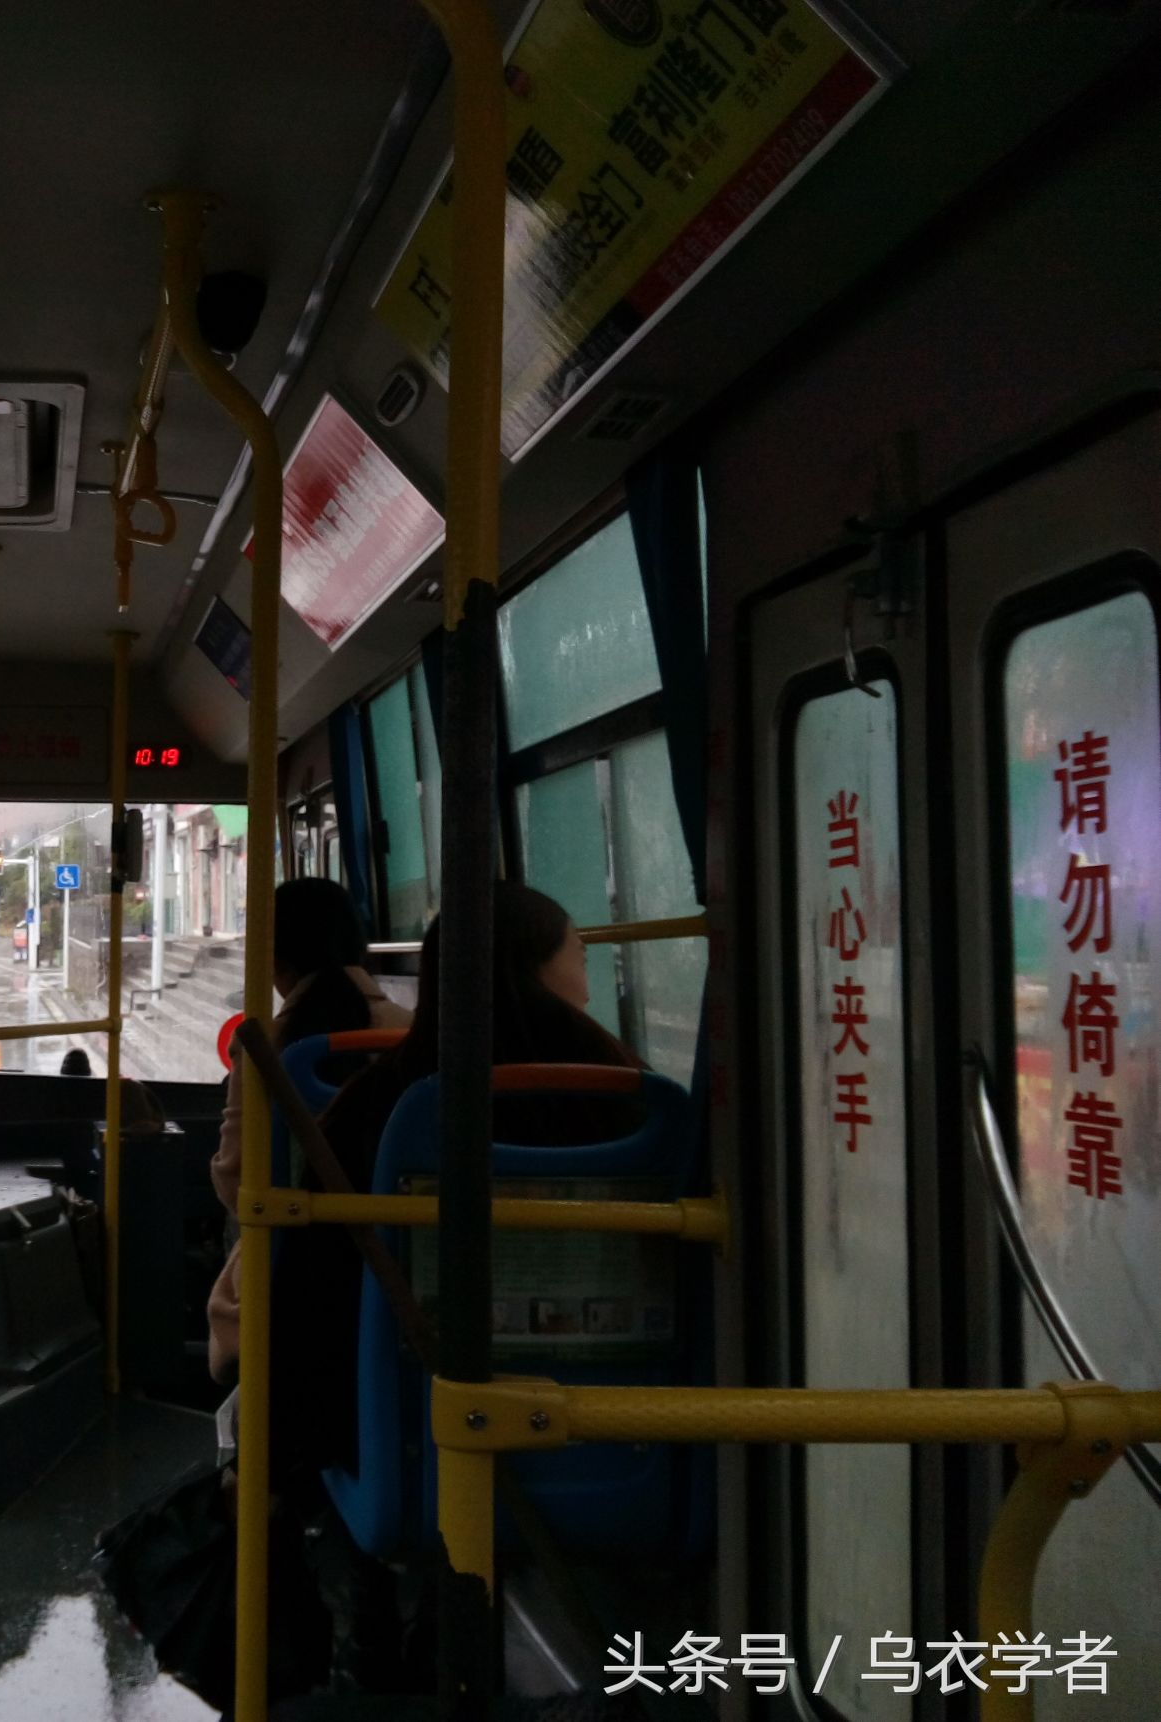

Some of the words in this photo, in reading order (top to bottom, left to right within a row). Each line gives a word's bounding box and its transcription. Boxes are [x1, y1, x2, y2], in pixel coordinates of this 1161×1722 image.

[827, 790, 871, 1153] 当心夹手
[1054, 731, 1123, 1199] 请勿倚靠
